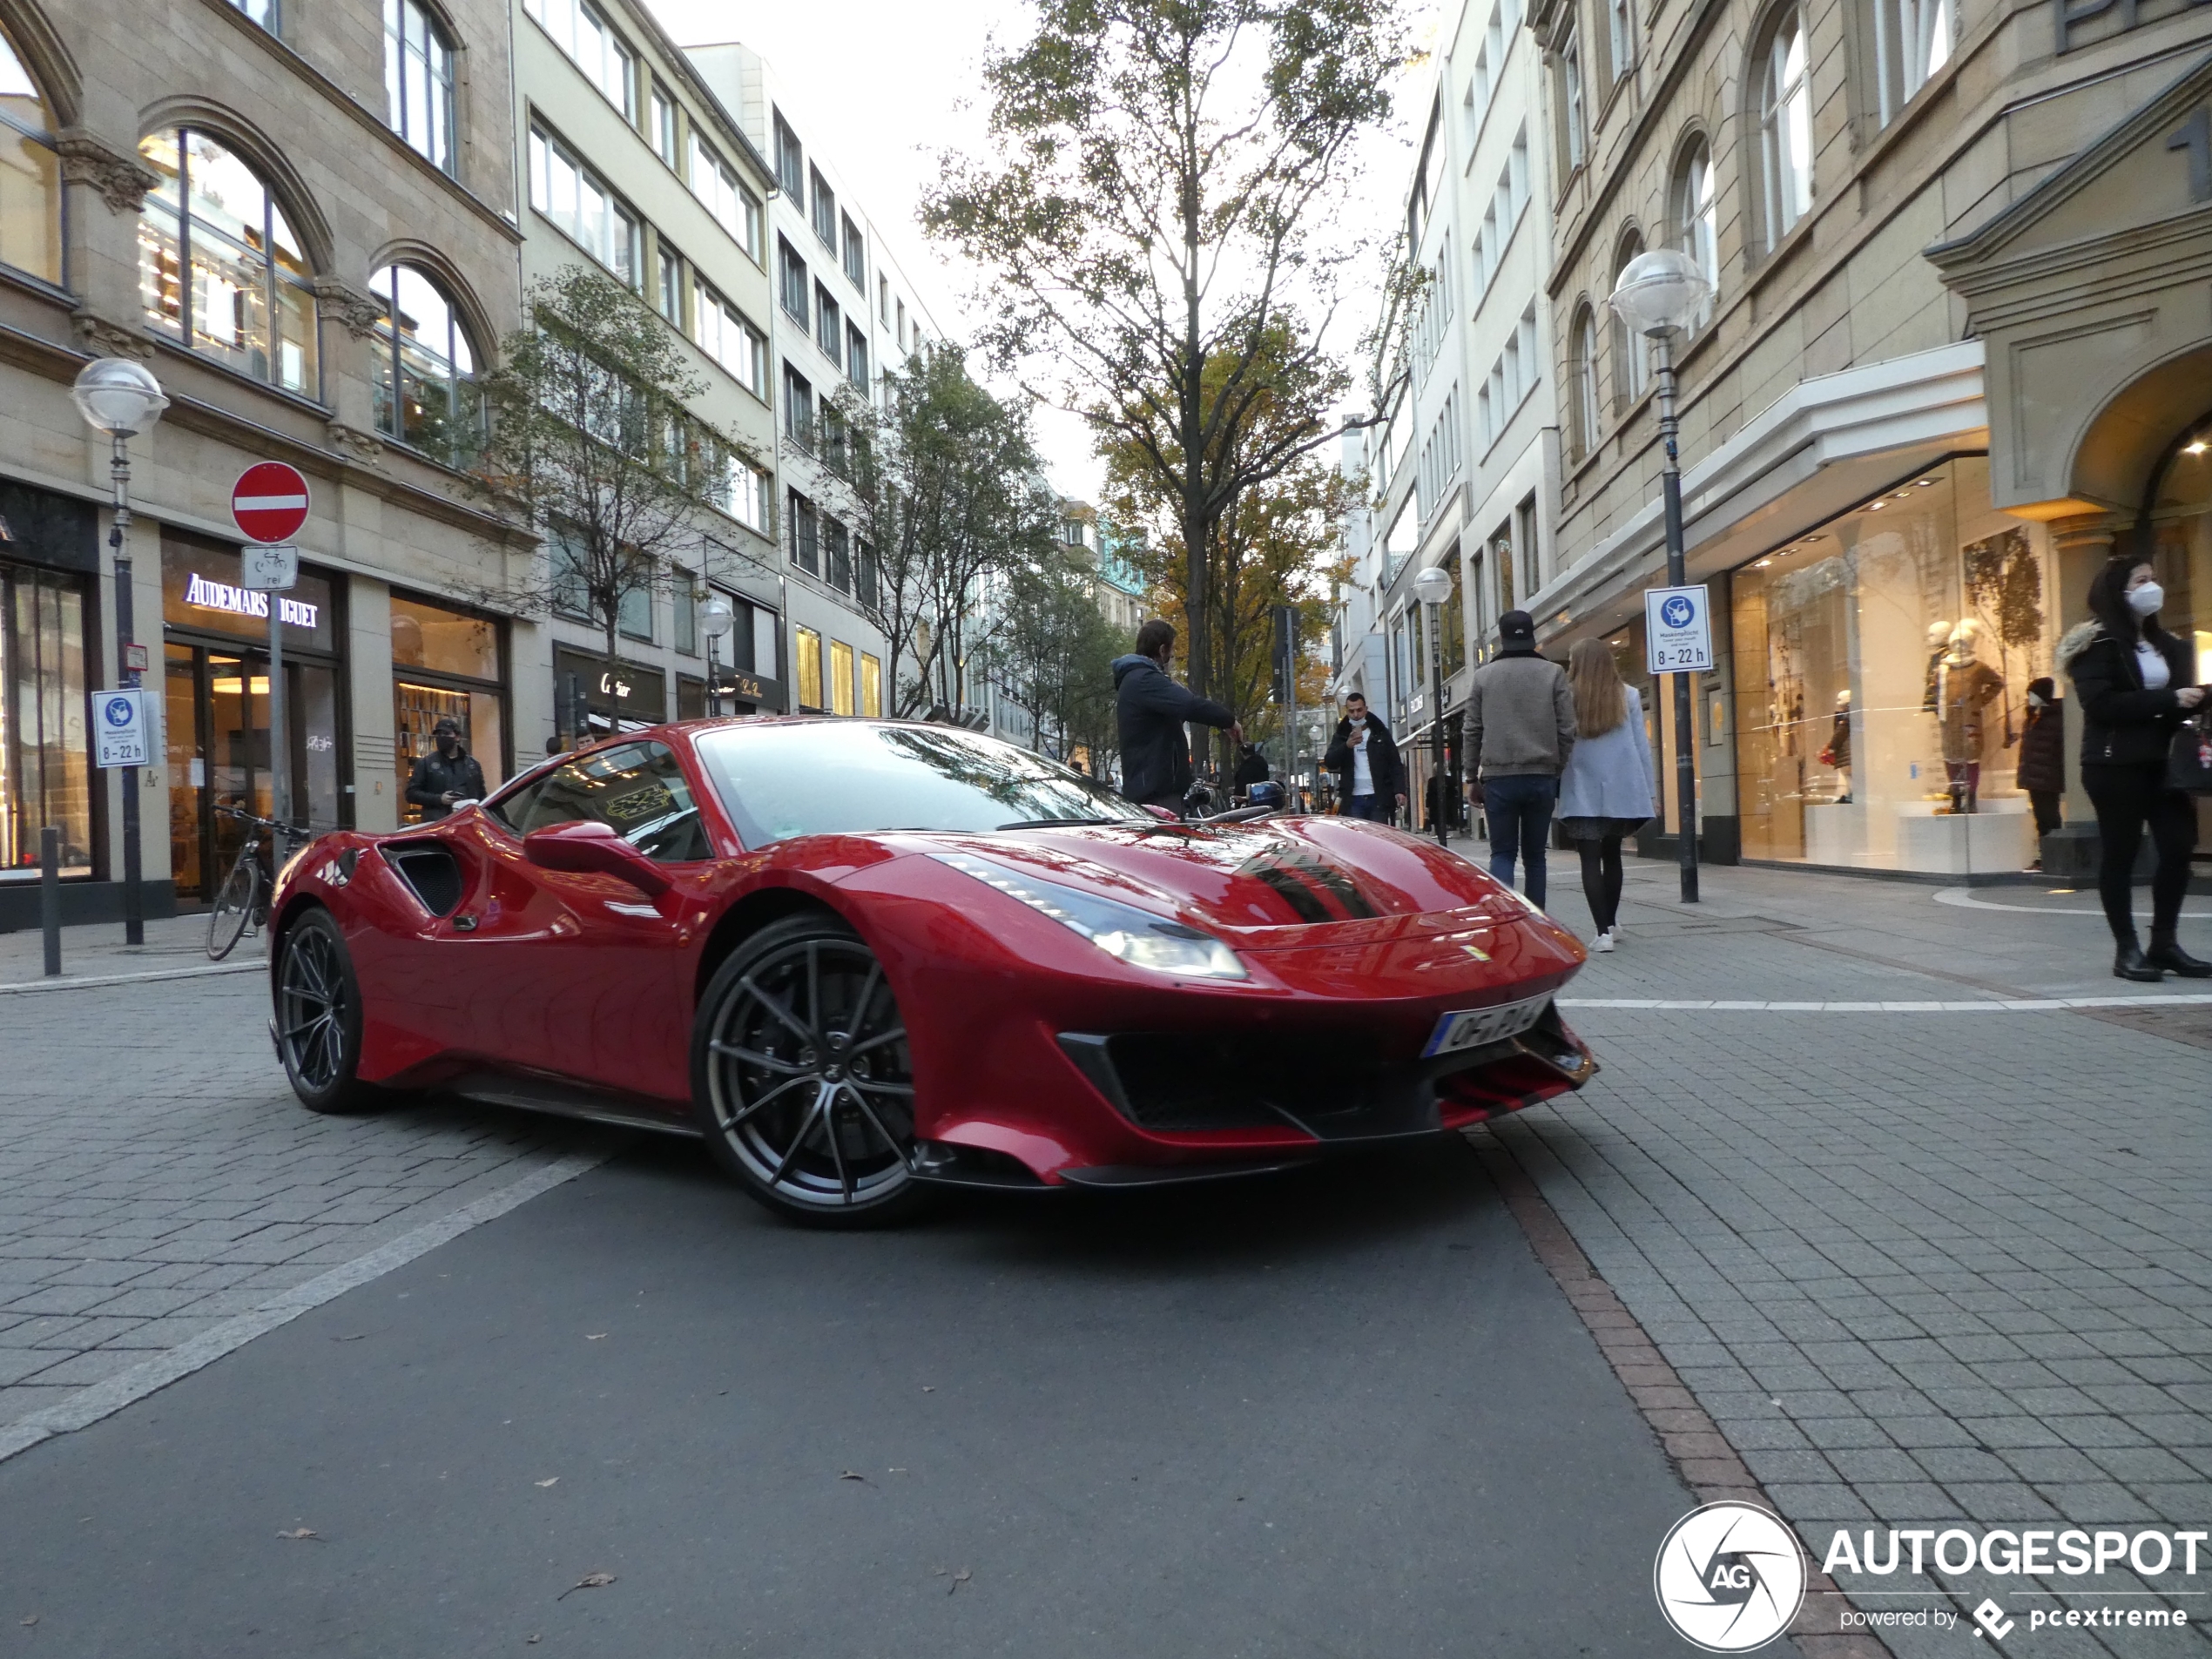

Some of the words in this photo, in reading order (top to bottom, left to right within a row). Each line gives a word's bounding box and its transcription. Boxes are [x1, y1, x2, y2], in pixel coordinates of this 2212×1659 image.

[185, 572, 269, 617] AUDEMARS
[279, 597, 318, 628] IGUET
[1659, 630, 1699, 638] Maskenpflicht
[1658, 651, 1665, 665] 8
[1677, 648, 1693, 664] 22
[1696, 647, 1704, 662] h
[600, 672, 631, 698] Catier
[103, 746, 110, 759] 8
[120, 745, 132, 759] 22
[134, 744, 141, 758] h
